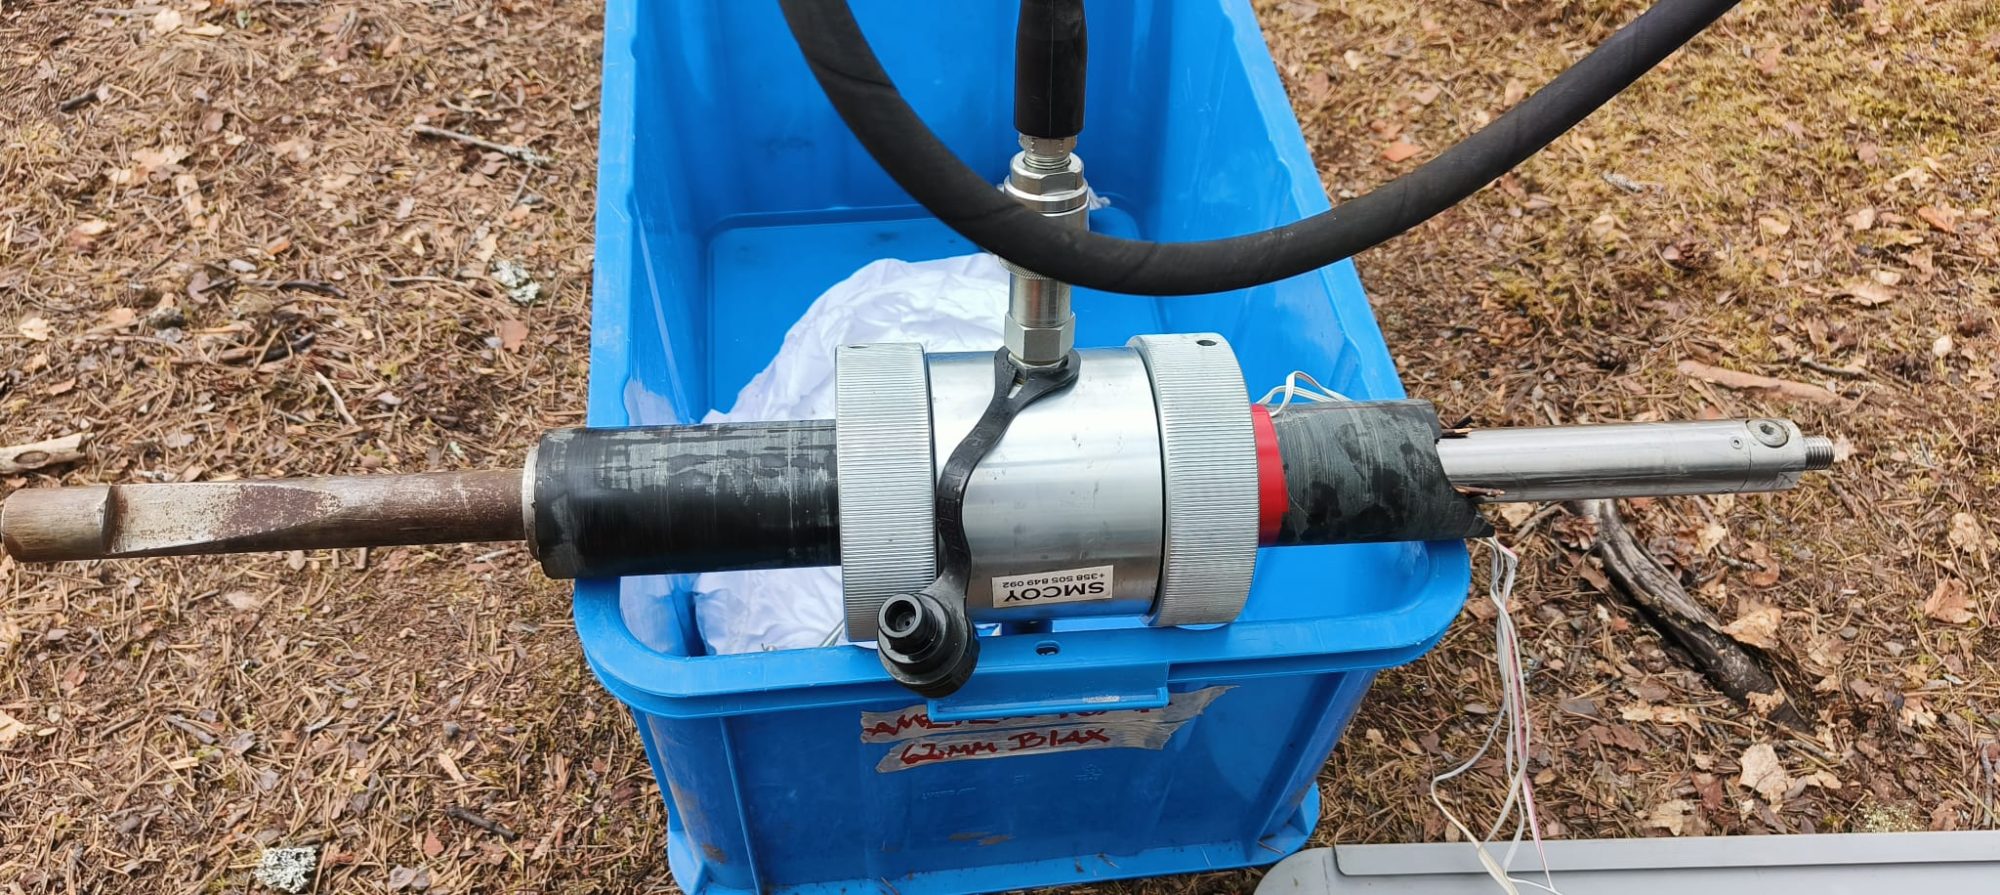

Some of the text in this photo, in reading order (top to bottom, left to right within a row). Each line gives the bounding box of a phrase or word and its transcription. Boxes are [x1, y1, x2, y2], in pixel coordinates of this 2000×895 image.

[1002, 572, 1105, 588] +358 505 849 092
[1003, 582, 1105, 602] SMCOY
[1008, 728, 1111, 751] BIAX
